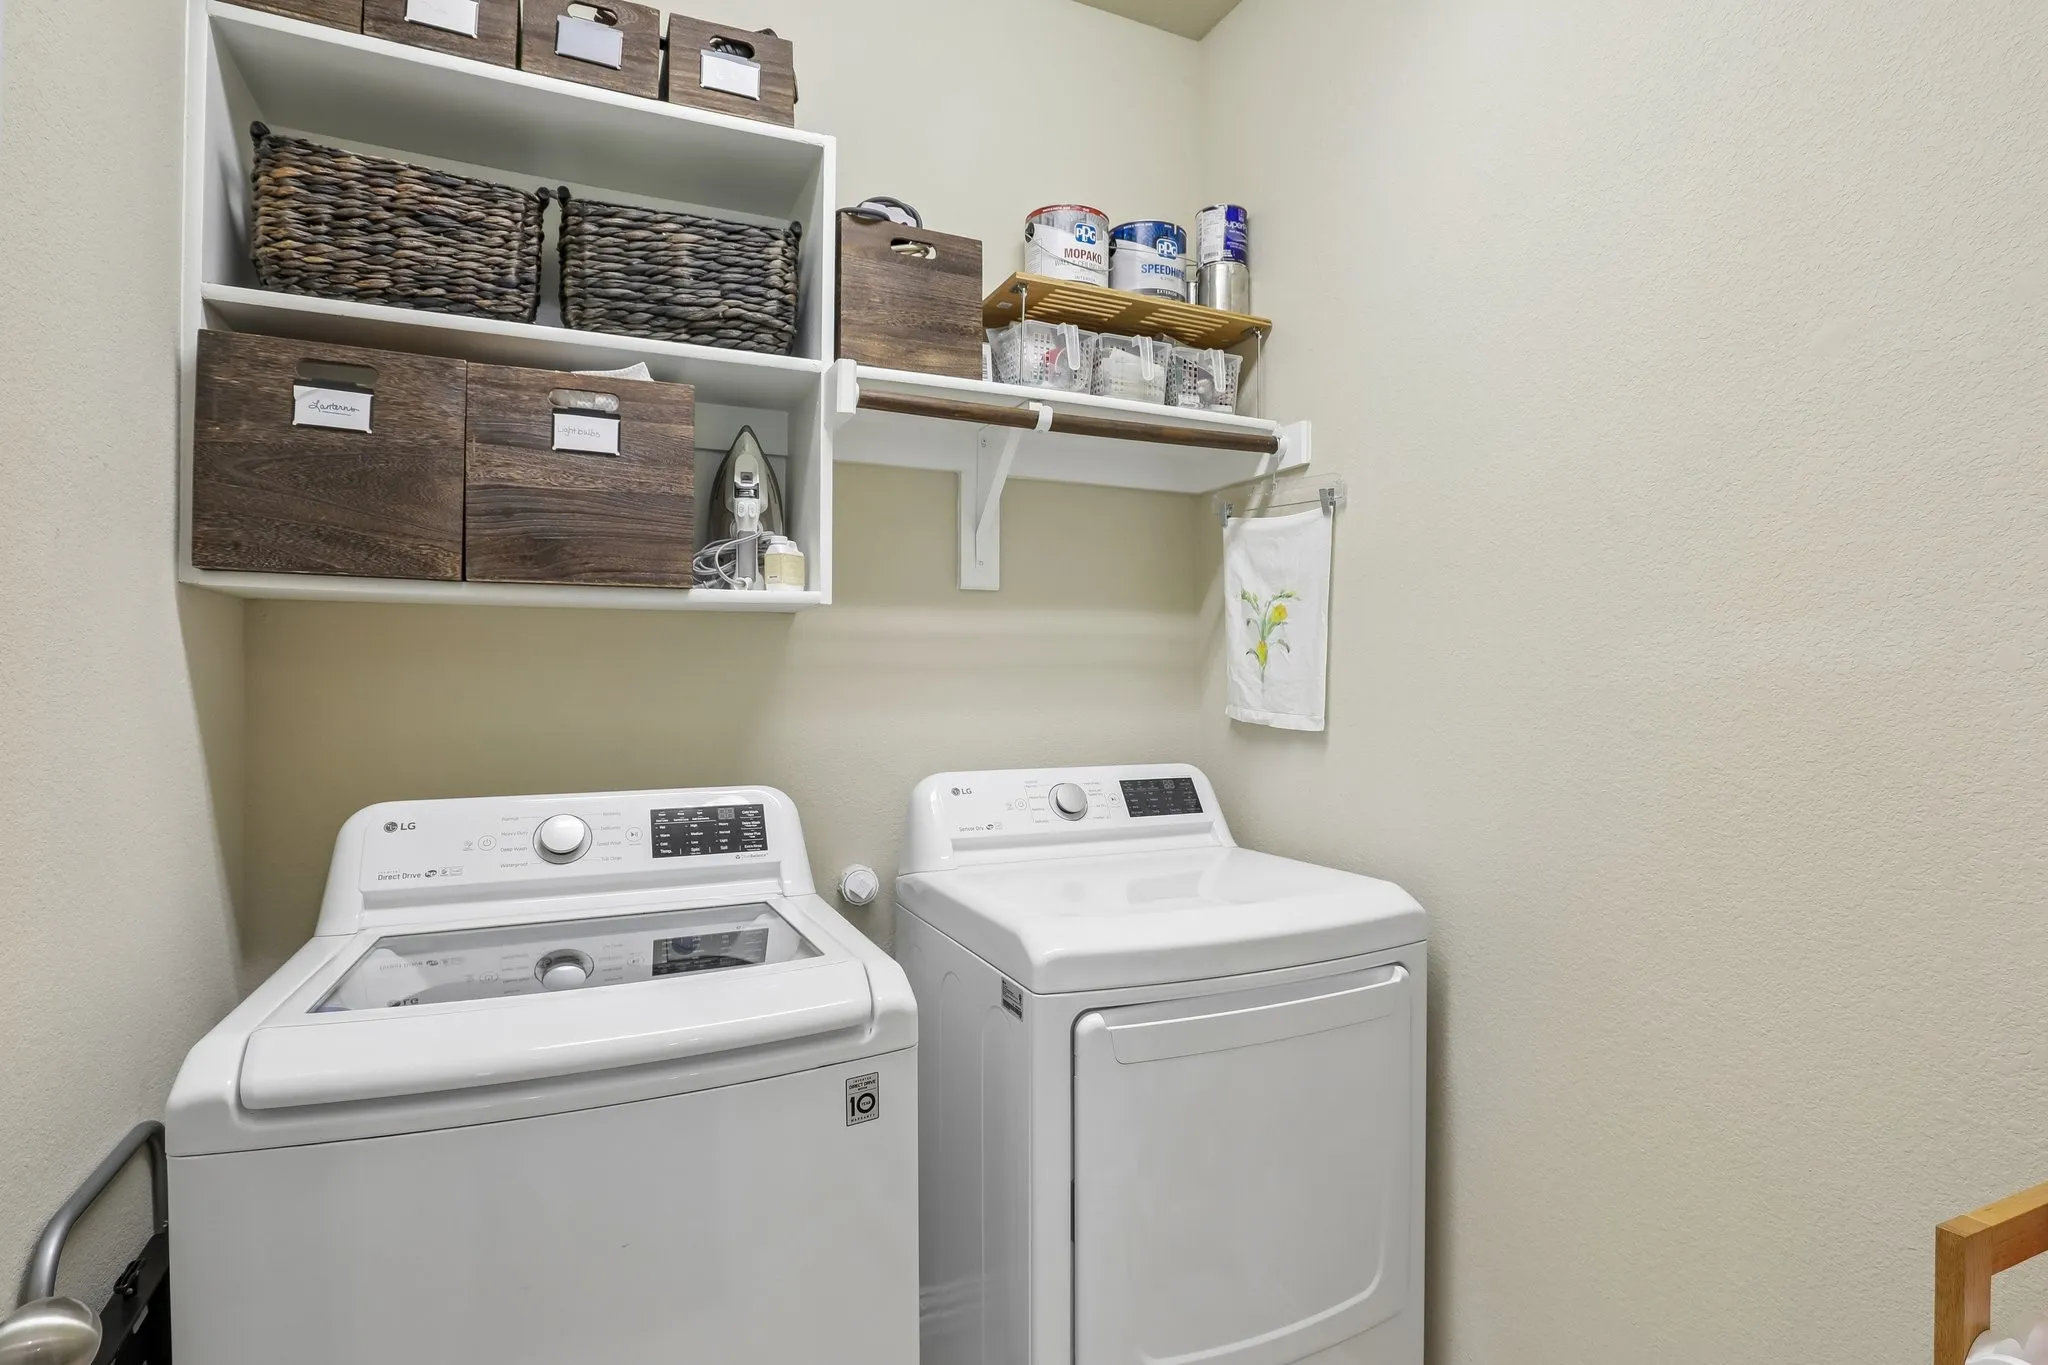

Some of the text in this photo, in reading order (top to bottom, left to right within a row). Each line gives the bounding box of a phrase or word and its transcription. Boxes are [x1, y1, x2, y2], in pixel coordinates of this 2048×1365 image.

[1076, 225, 1096, 242] PPG
[1158, 241, 1177, 257] PPG
[1064, 248, 1102, 265] MOPAKO
[308, 400, 360, 412] Lanterns
[961, 787, 972, 795] LG
[400, 822, 416, 831] LG
[377, 873, 401, 881] Direct
[402, 872, 421, 880] Drive
[850, 1093, 875, 1116] 10
